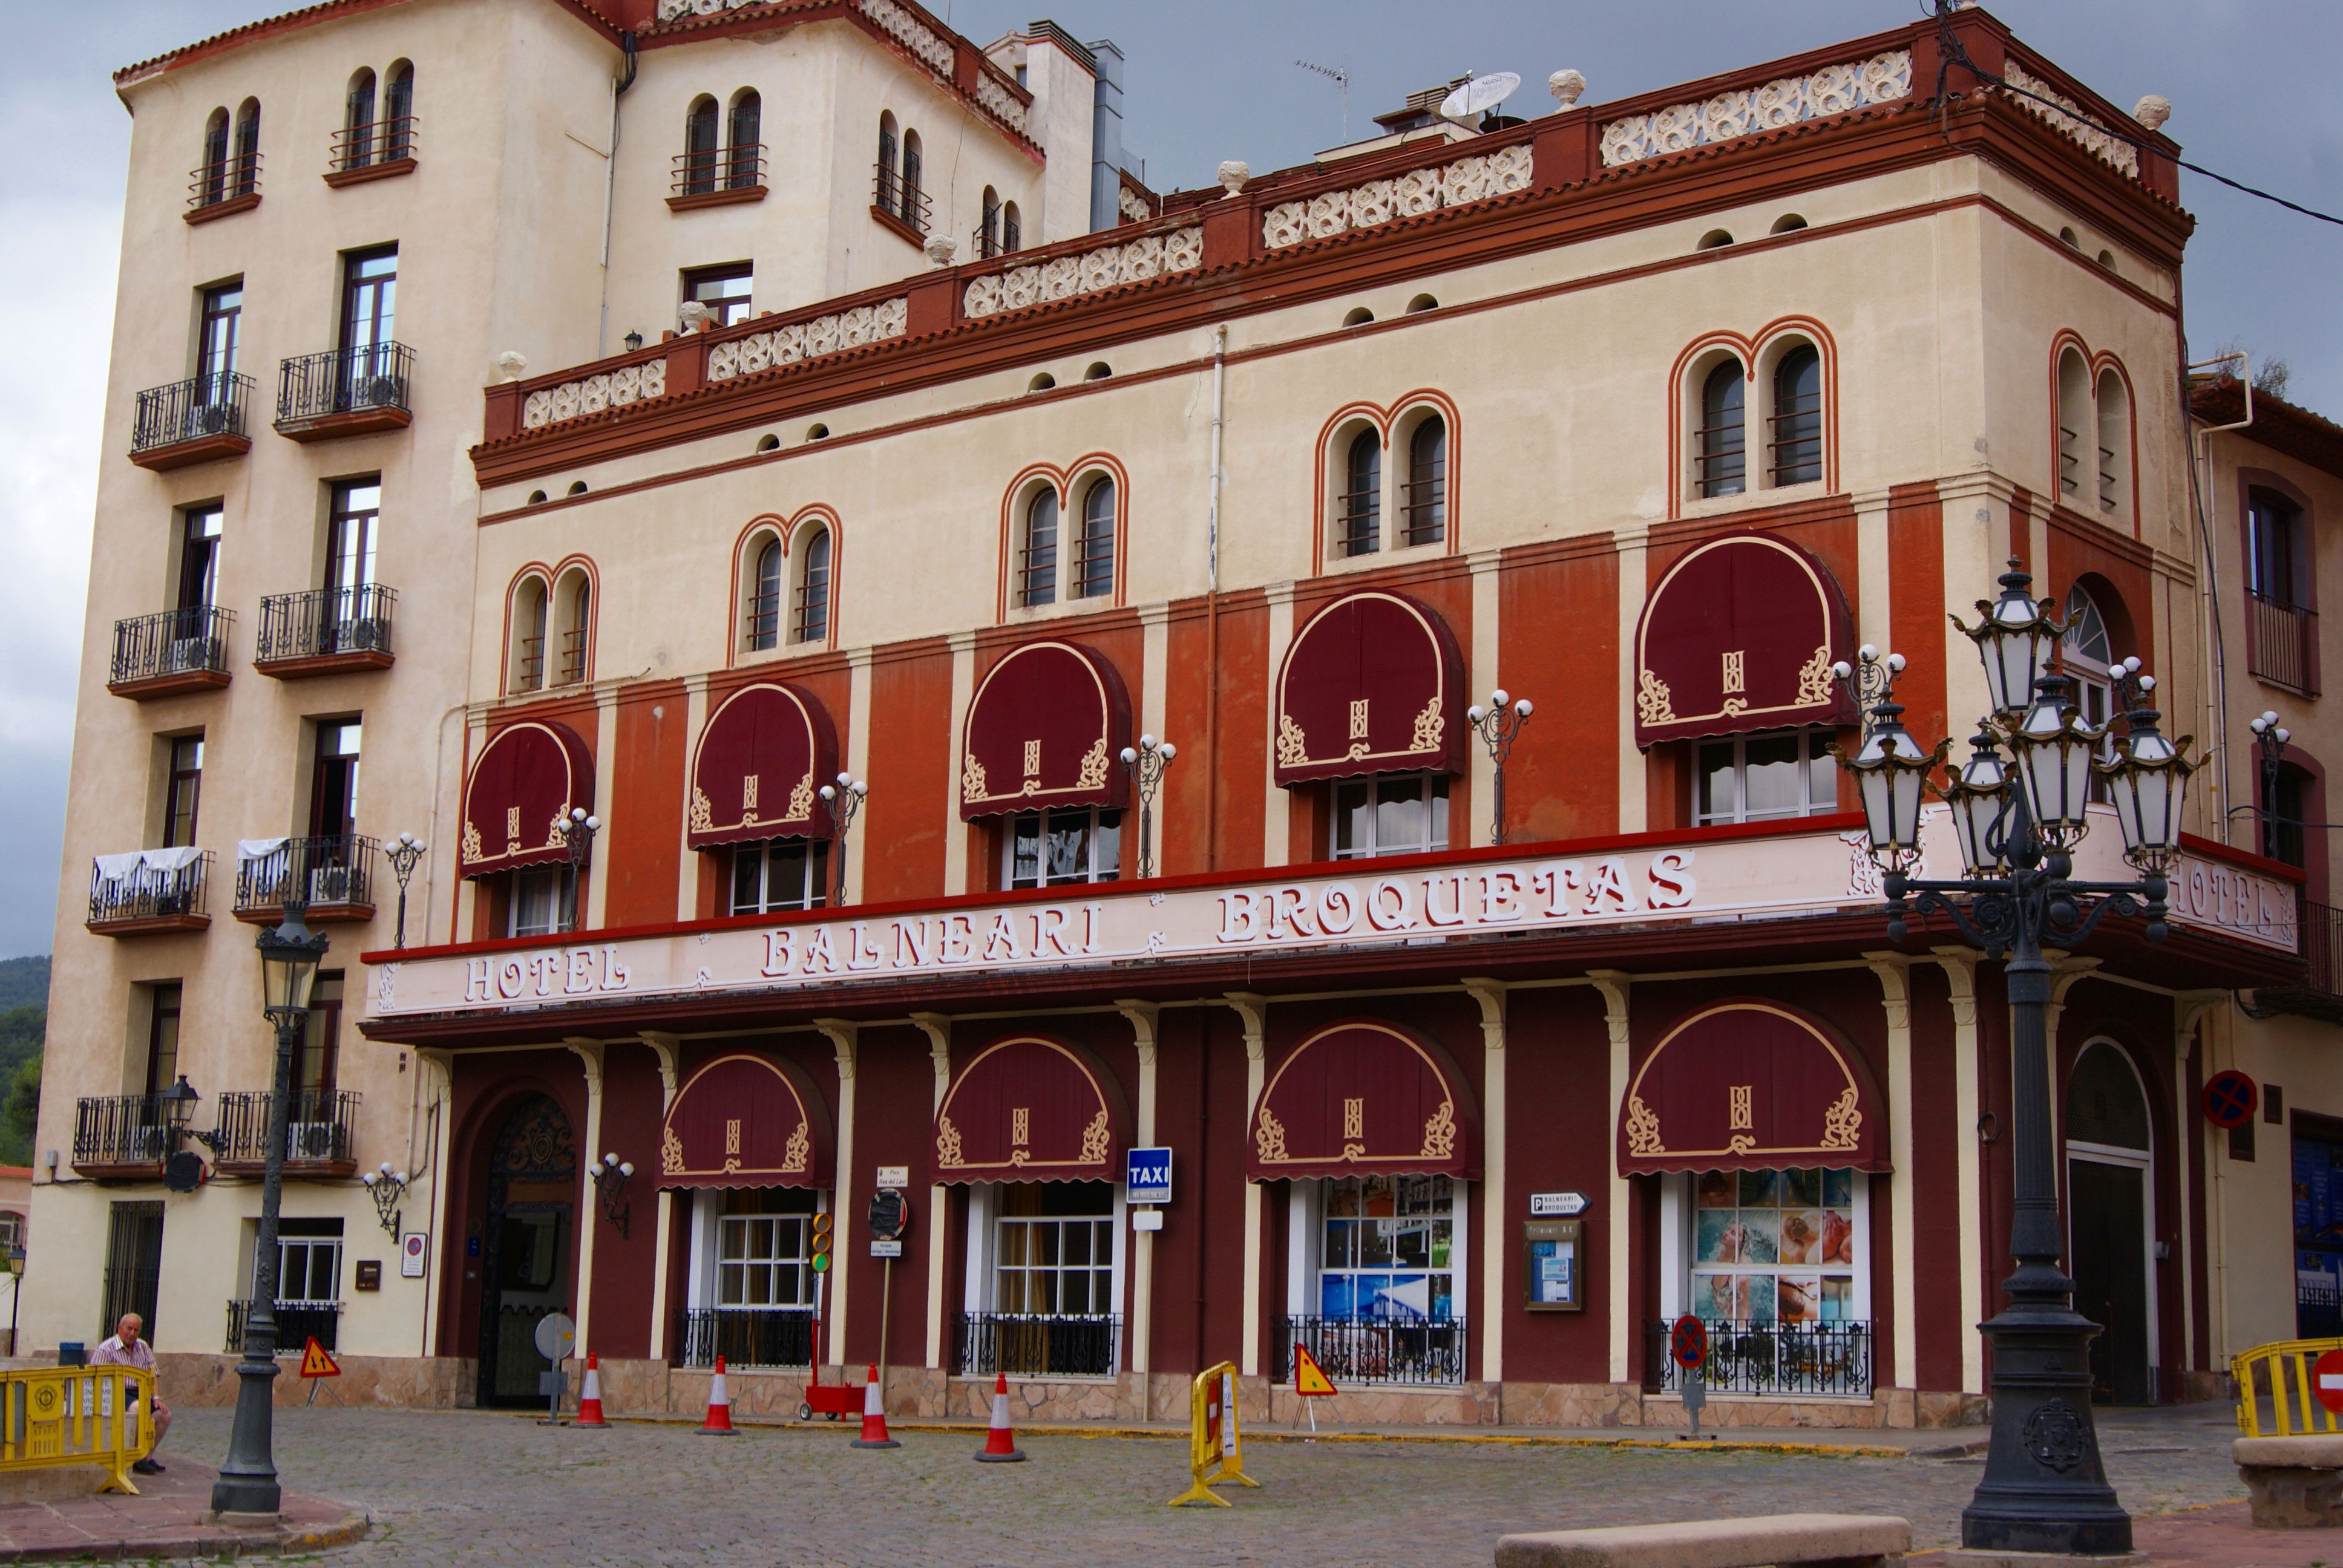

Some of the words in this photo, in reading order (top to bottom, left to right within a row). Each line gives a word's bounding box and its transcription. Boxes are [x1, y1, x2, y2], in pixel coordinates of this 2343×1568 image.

[465, 943, 631, 1002] HOTEL
[761, 902, 1102, 978] BALNEARI
[1216, 849, 1696, 944] BROQUETAS
[2166, 859, 2273, 936] HOTEL
[1130, 1166, 1168, 1184] TAXI
